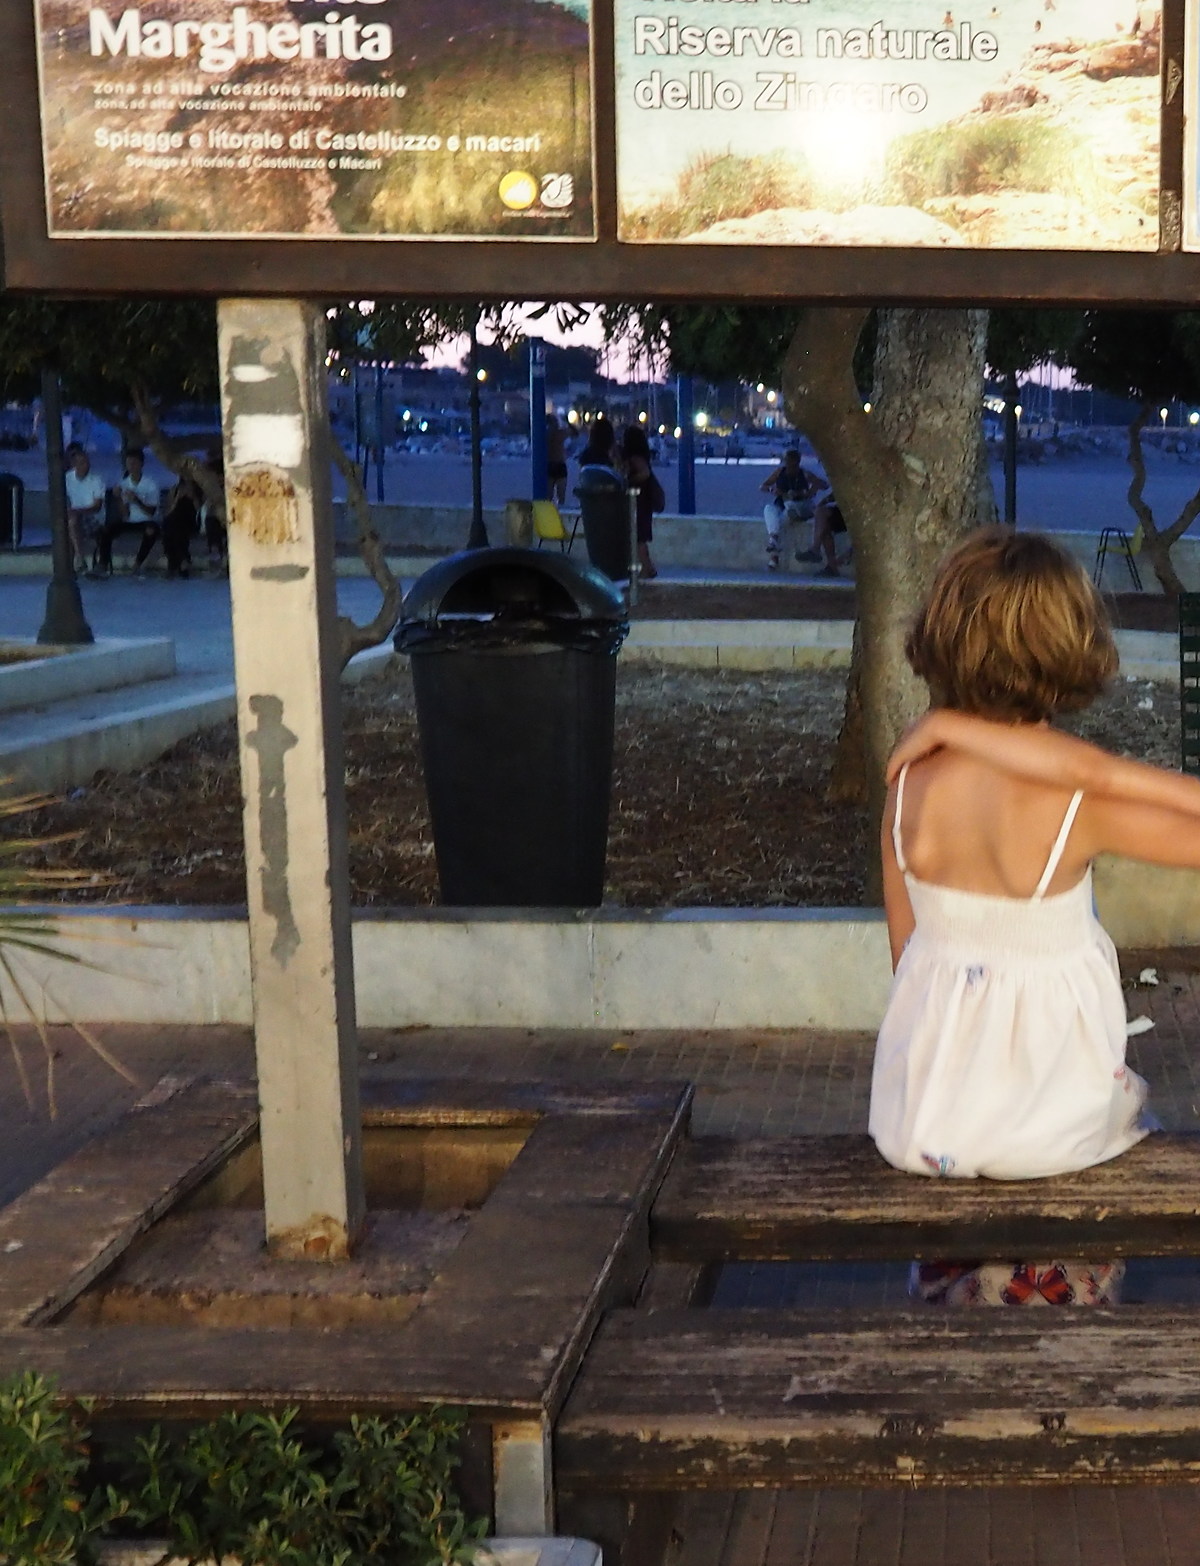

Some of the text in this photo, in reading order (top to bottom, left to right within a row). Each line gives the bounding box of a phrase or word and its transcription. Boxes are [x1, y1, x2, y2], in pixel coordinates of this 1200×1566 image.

[89, 6, 392, 73] Margherita
[634, 16, 999, 62] Riserva naturale
[93, 83, 138, 95] zona
[142, 82, 164, 95] ad
[209, 83, 300, 97] vocazione
[307, 83, 407, 98] ambientale
[634, 70, 743, 110] dello
[178, 99, 246, 111] vocazione
[249, 99, 322, 112] ambientale
[94, 126, 541, 153] Spiagge e litorale di Castelluzzo e macari
[125, 155, 179, 170] Spiagge
[252, 156, 326, 170] Castelluzzo
[328, 159, 337, 170] e
[339, 157, 382, 170] Macari
